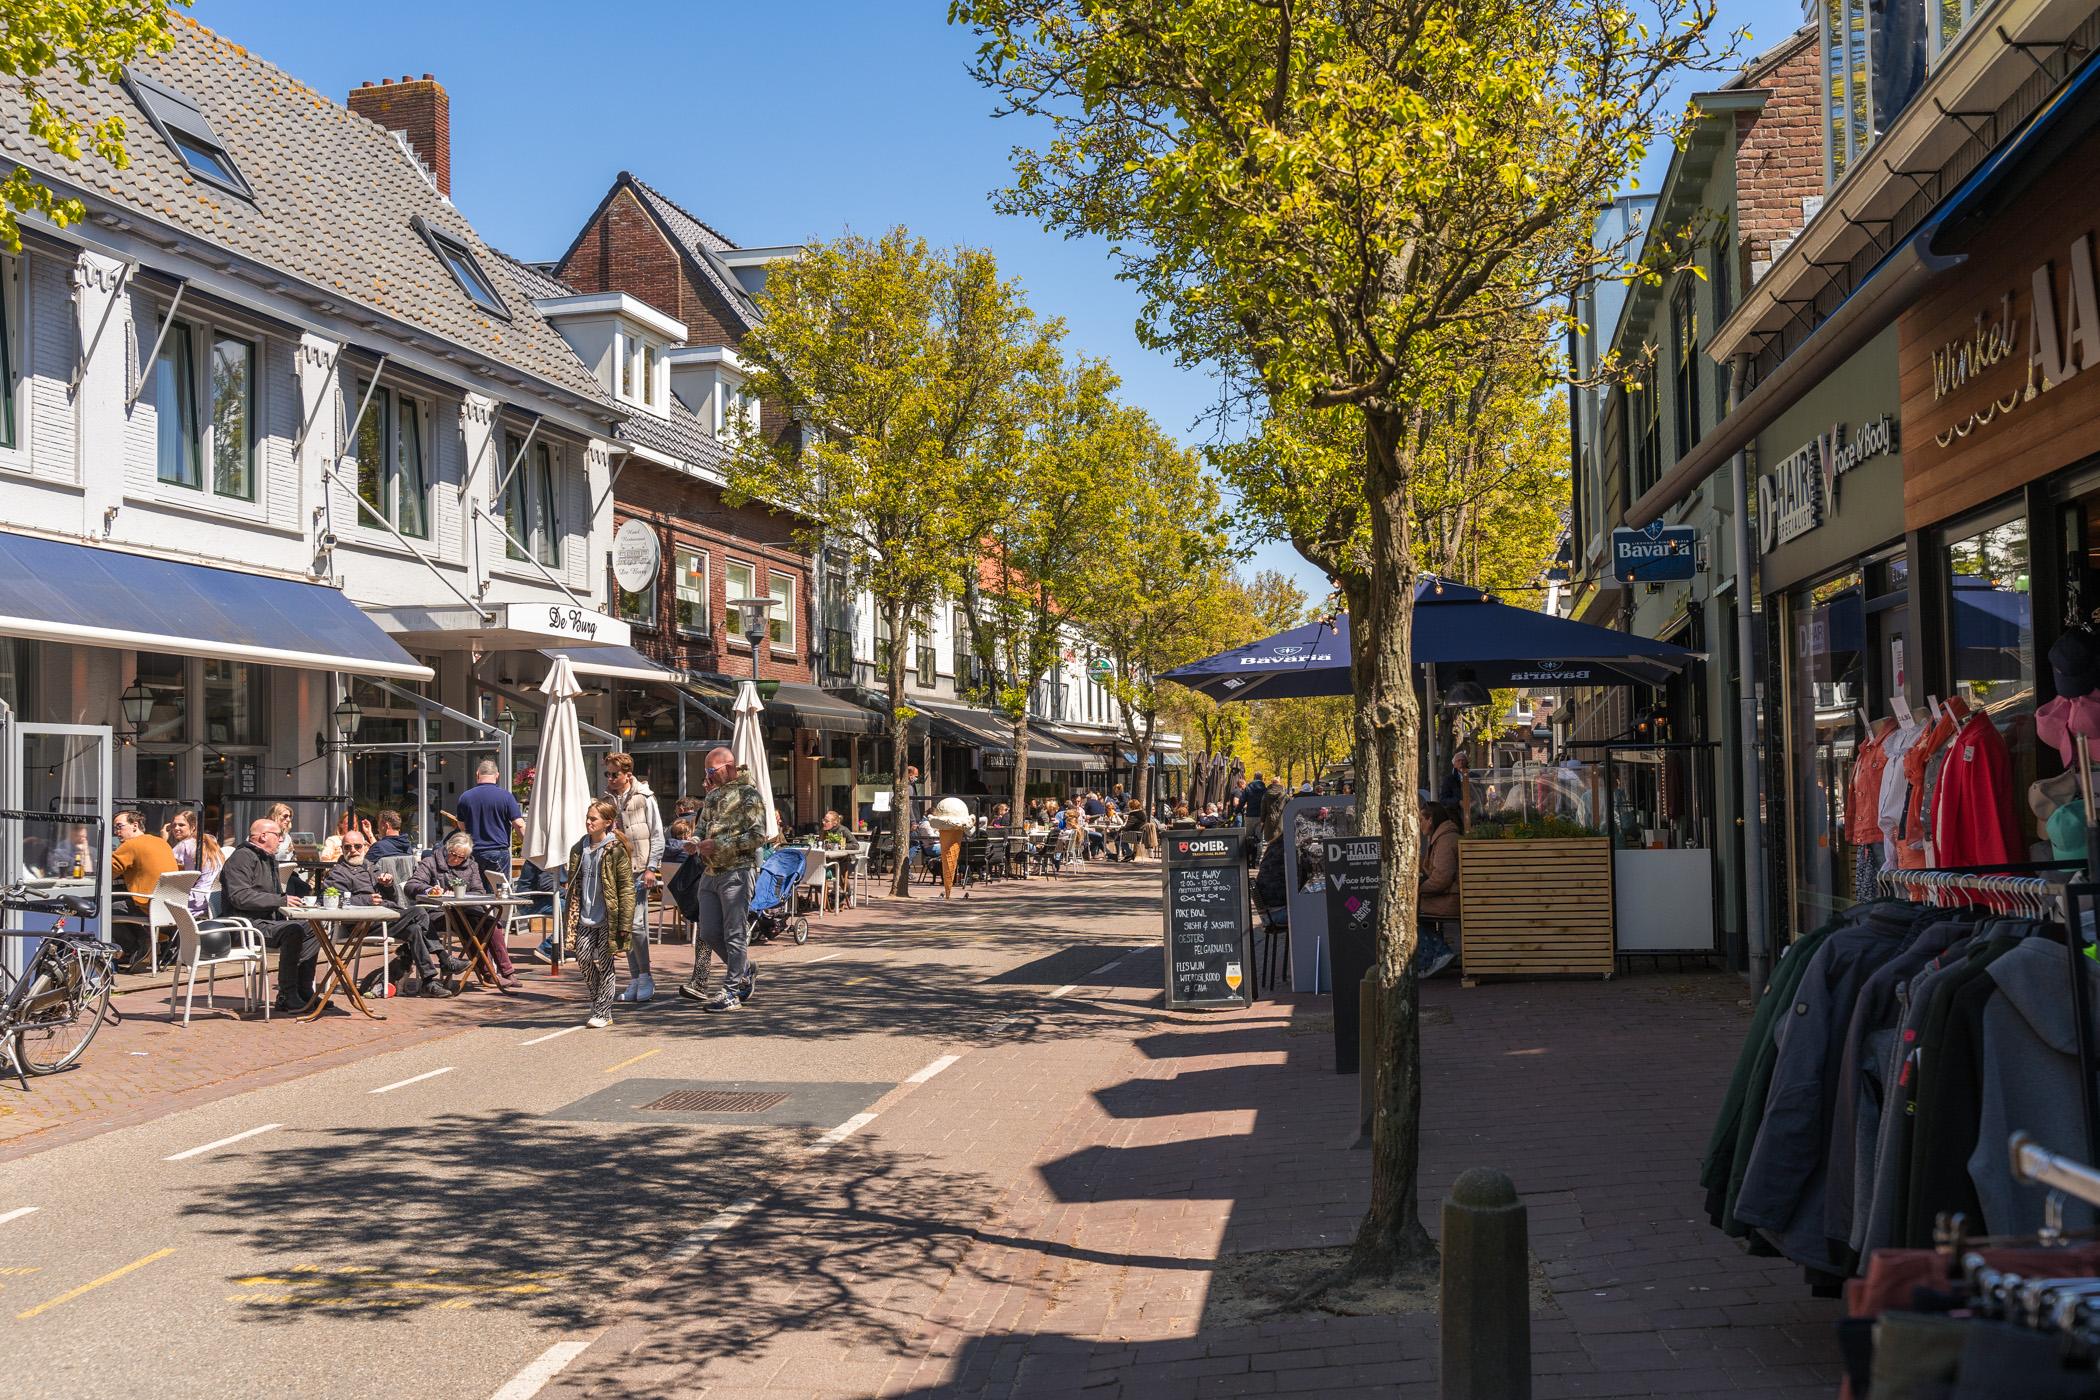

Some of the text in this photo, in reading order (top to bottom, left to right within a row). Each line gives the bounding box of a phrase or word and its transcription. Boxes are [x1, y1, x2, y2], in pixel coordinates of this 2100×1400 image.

[1931, 293, 2016, 401] Winkel
[1856, 427, 1864, 462] &
[1865, 413, 1889, 456] Body
[1758, 448, 1811, 556] D-HAIR
[1778, 508, 1811, 540] SPECIALIST
[1618, 542, 1691, 559] Bavara
[549, 606, 598, 641] De Burg
[1240, 653, 1333, 665] Bavaria
[1527, 687, 1560, 697] MUSEU
[1189, 840, 1229, 852] OMER.
[1327, 843, 1378, 862] D-HAIR
[1181, 870, 1221, 880] TAKE AWAY
[1365, 875, 1379, 883] Bod
[1175, 908, 1207, 918] POKE BOWL
[1183, 921, 1201, 930] SUSHI
[1211, 921, 1235, 930] SASHIMI
[1178, 933, 1205, 944] OESTERS
